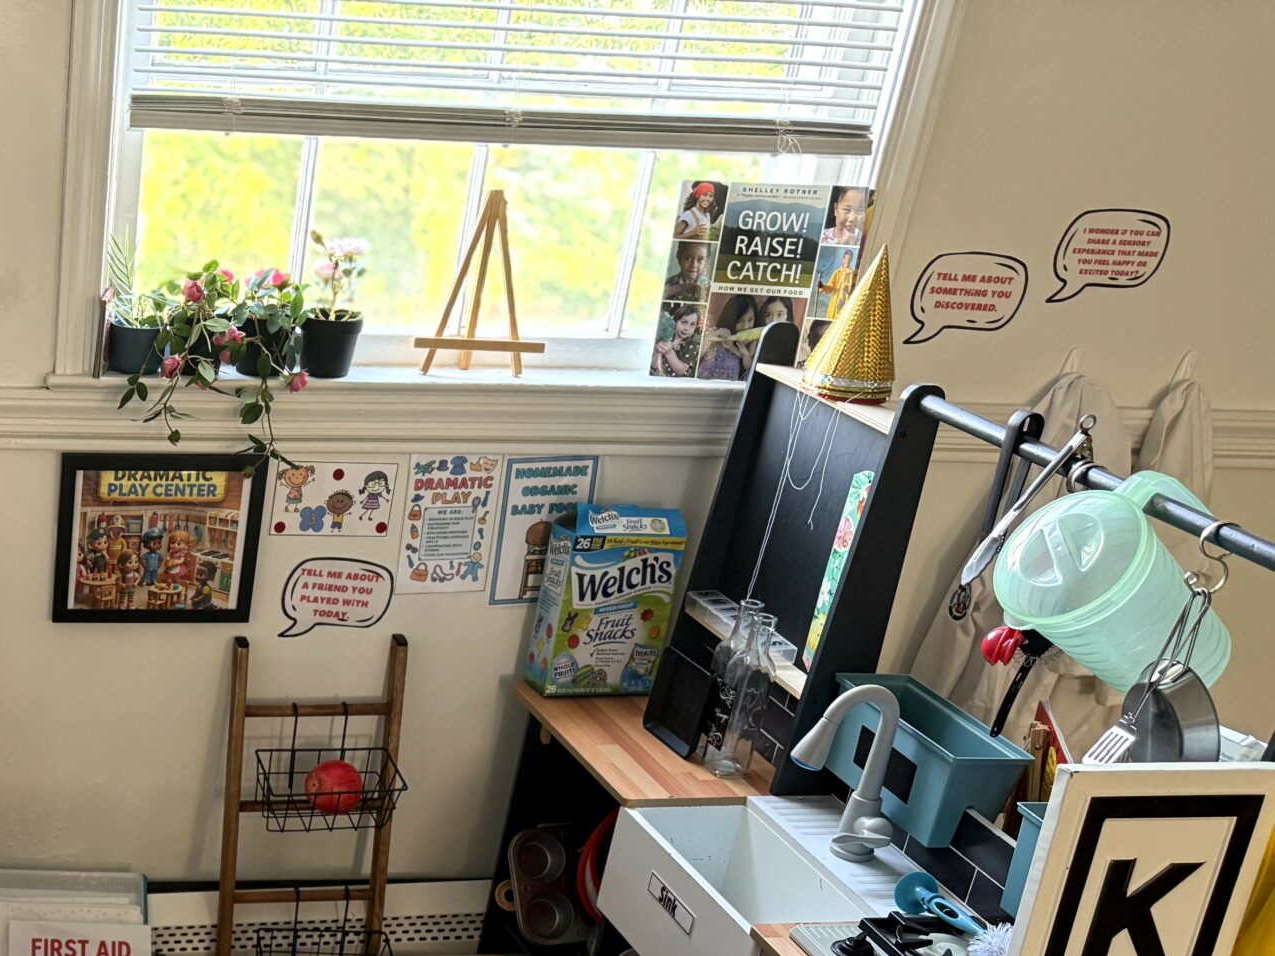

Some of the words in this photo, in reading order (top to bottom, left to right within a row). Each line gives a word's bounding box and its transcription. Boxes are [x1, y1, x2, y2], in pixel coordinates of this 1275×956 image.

[738, 210, 810, 233] GROW!
[734, 236, 804, 258] RAISE!
[726, 260, 802, 284] CATCH!
[937, 272, 959, 281] TELL
[961, 274, 977, 283] ME
[979, 275, 1014, 285] ABOUT
[991, 290, 1012, 299] YOU
[114, 470, 213, 481] DRAMATIC
[515, 465, 589, 480] HOMEMADE
[107, 483, 149, 496] PLAY
[152, 484, 217, 497] CENTER
[414, 476, 494, 491] DRAMATIC
[431, 491, 471, 504] PLAY
[522, 484, 578, 498] ORGANIC
[511, 502, 545, 516] BABY
[310, 513, 317, 525] 3
[589, 511, 619, 525] Welch's
[575, 538, 590, 549] 26
[300, 568, 324, 577] TELL
[326, 570, 343, 579] ME
[345, 572, 381, 582] ABOUT
[575, 556, 672, 602] Welch's
[351, 586, 373, 595] YOU
[300, 594, 339, 605] PLAYED
[597, 615, 633, 631] Fruit
[583, 628, 636, 645] Snacks
[554, 661, 574, 671] WHOLE
[546, 685, 557, 693] 26
[659, 886, 677, 917] Sink
